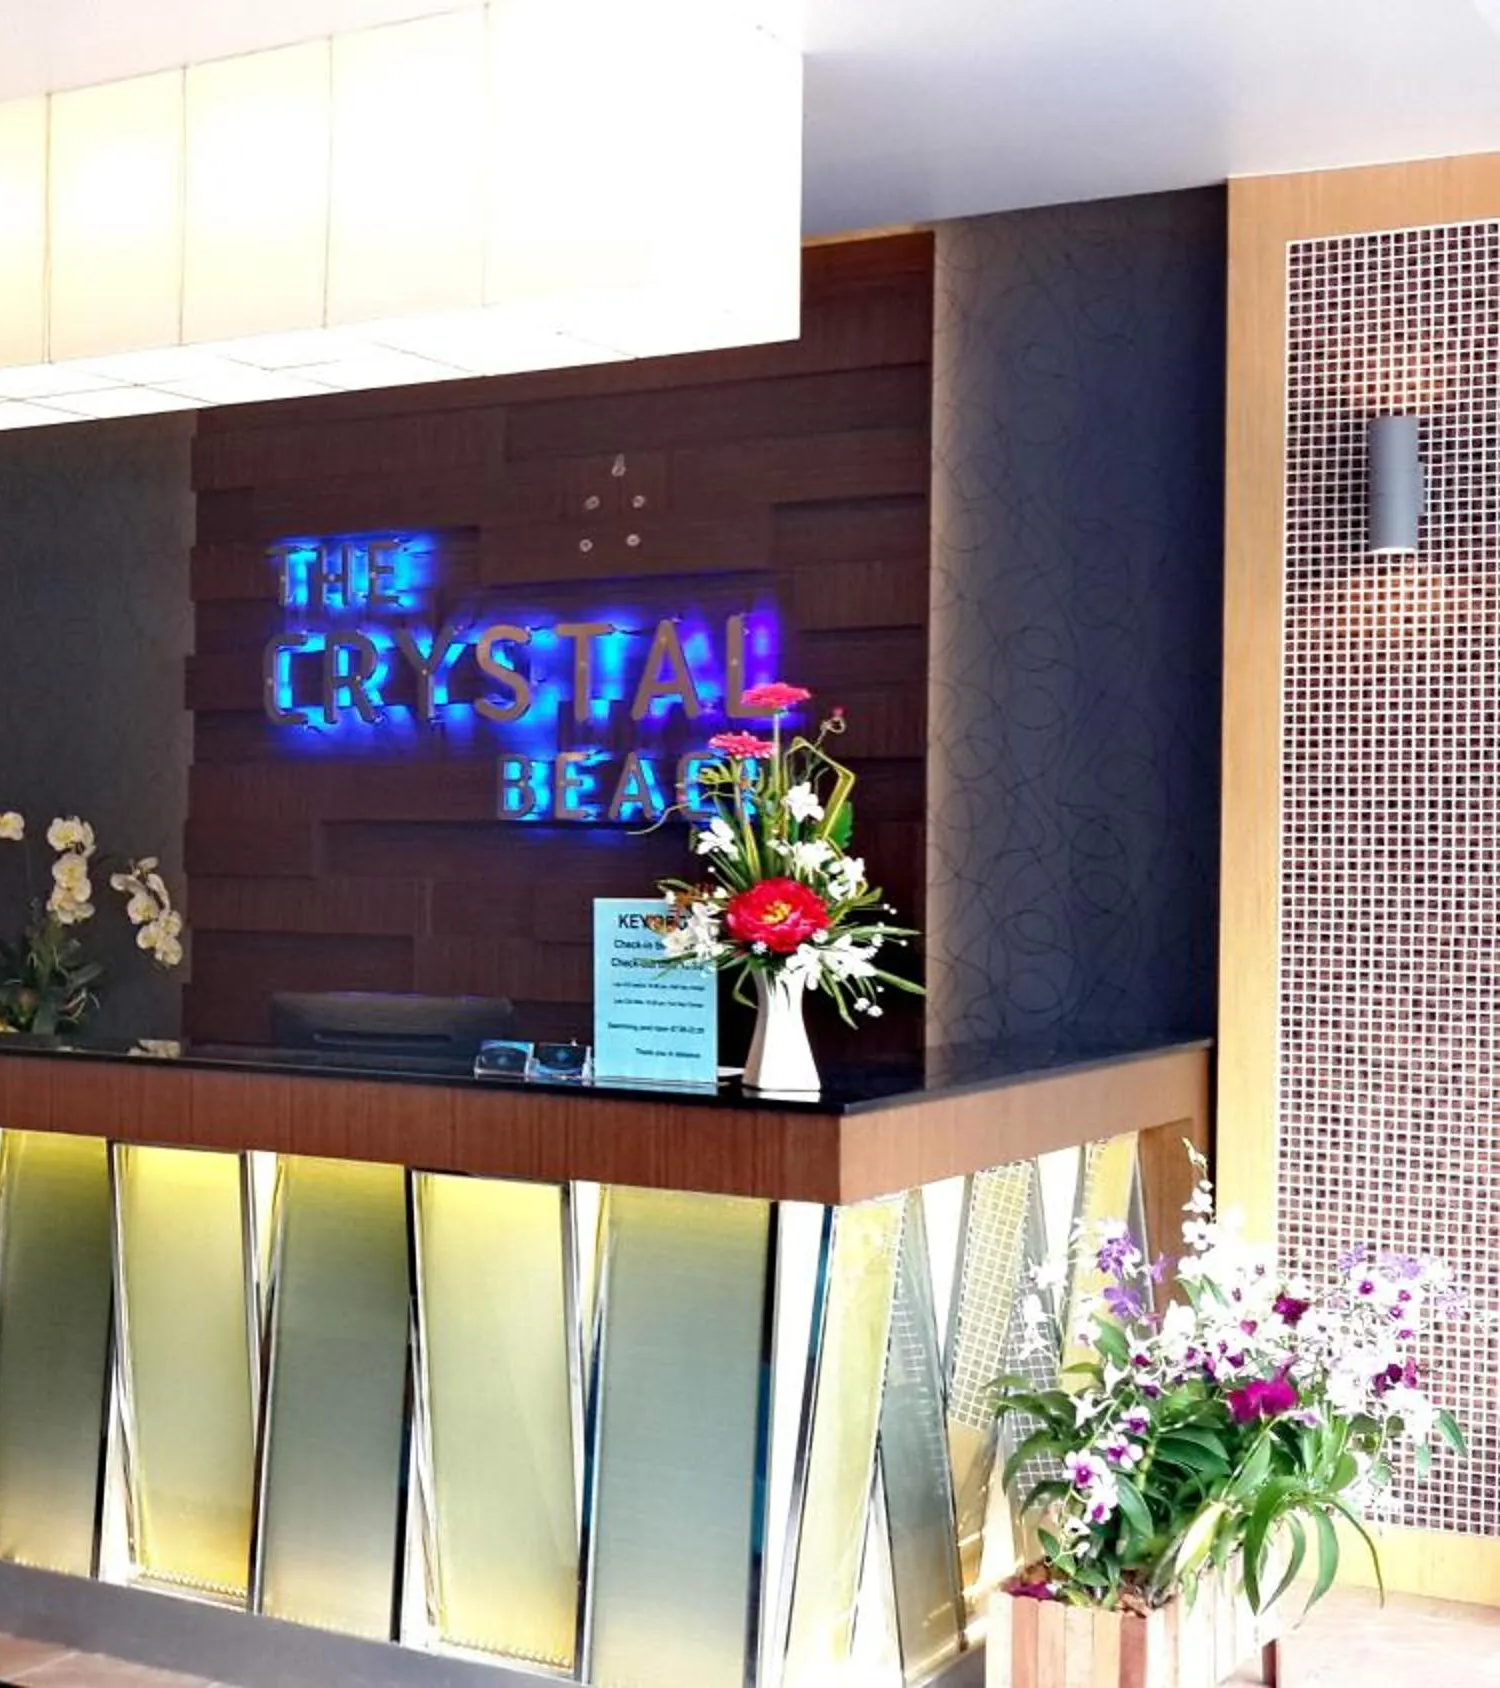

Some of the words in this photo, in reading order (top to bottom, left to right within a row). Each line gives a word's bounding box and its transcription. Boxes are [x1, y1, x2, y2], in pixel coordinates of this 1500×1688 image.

[266, 540, 402, 608] THE
[263, 613, 778, 726] CRYSTAL
[498, 750, 768, 822] BEAC
